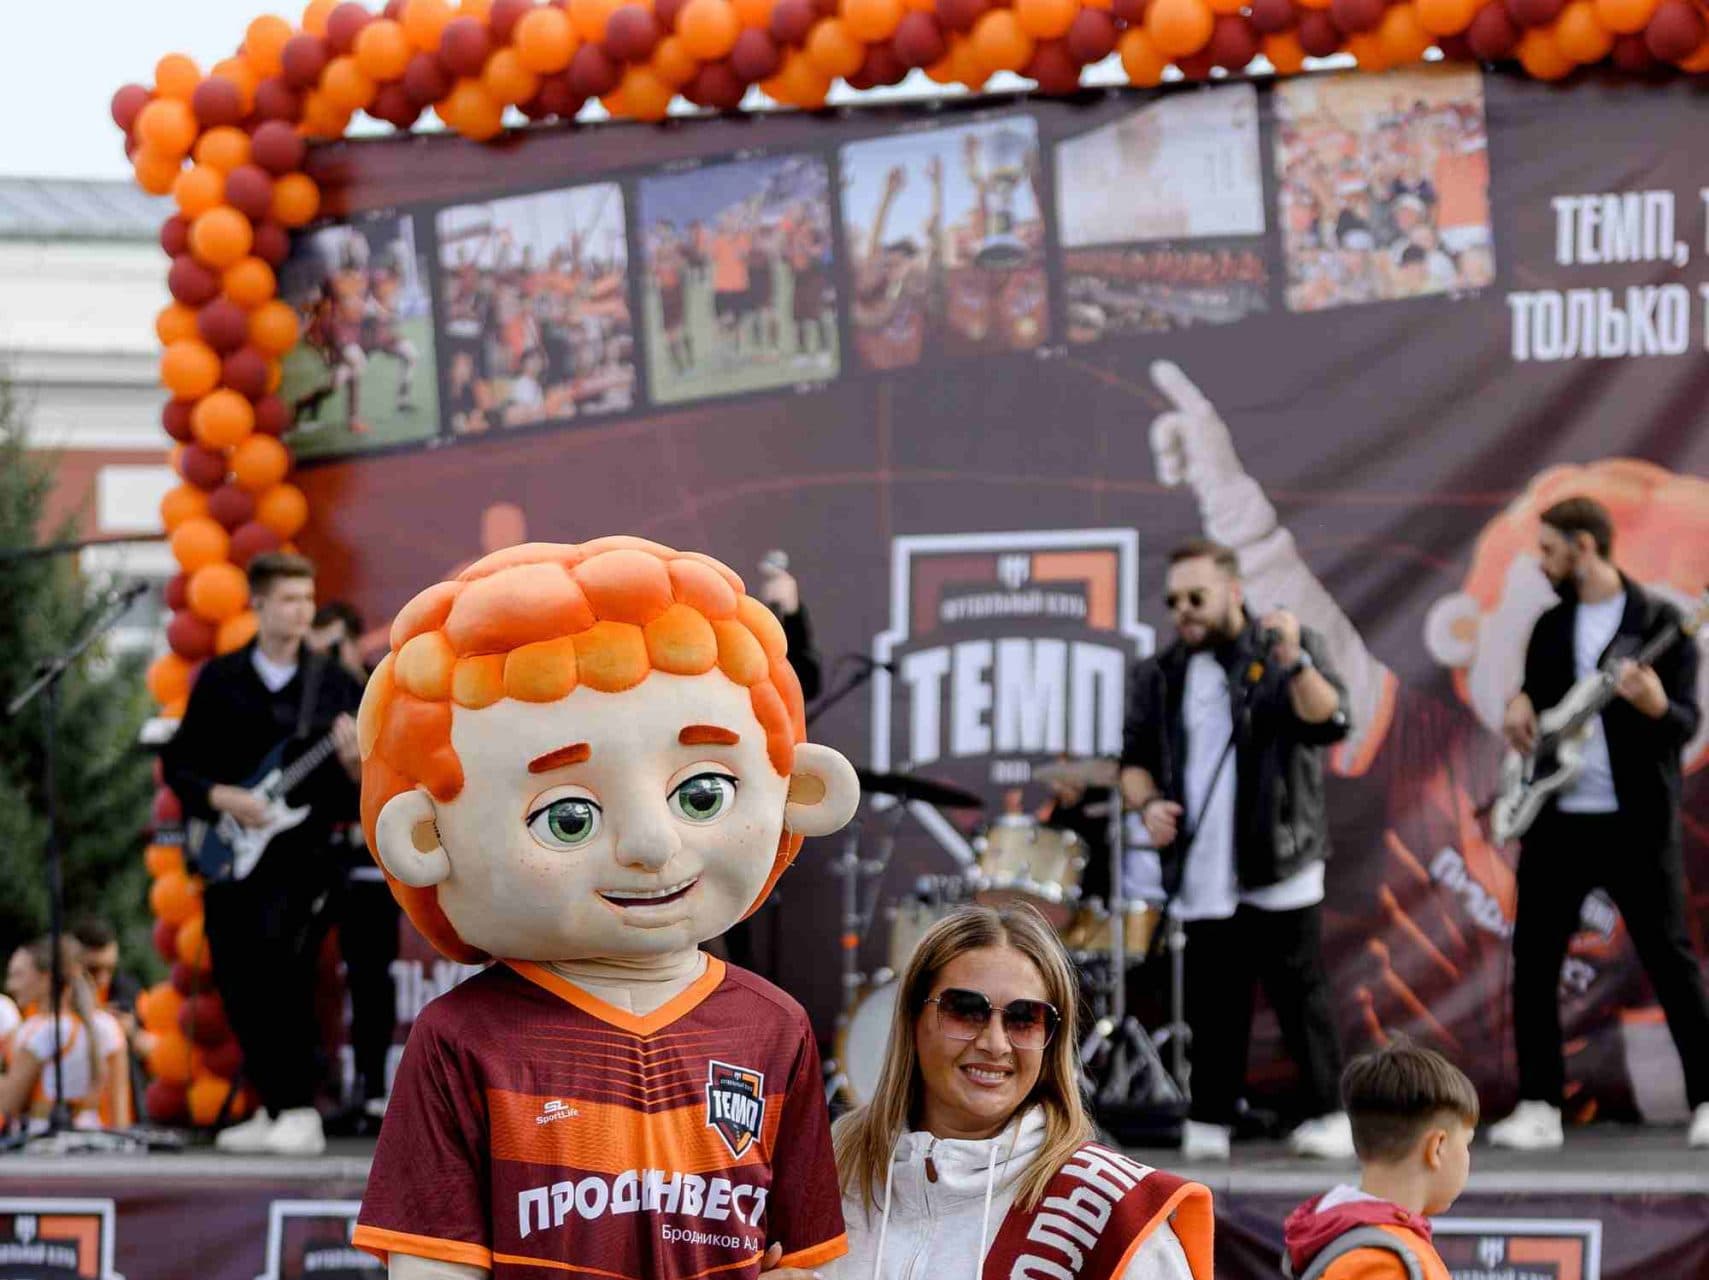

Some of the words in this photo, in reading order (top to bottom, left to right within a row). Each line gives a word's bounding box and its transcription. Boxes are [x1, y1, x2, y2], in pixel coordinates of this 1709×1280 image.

[1552, 189, 1690, 268] ТЕМП,
[1506, 283, 1691, 362] ТОЛЬКО
[903, 637, 1125, 766] ТЕМП
[712, 1089, 759, 1132] ТЕМП
[662, 1224, 740, 1249] Бродников
